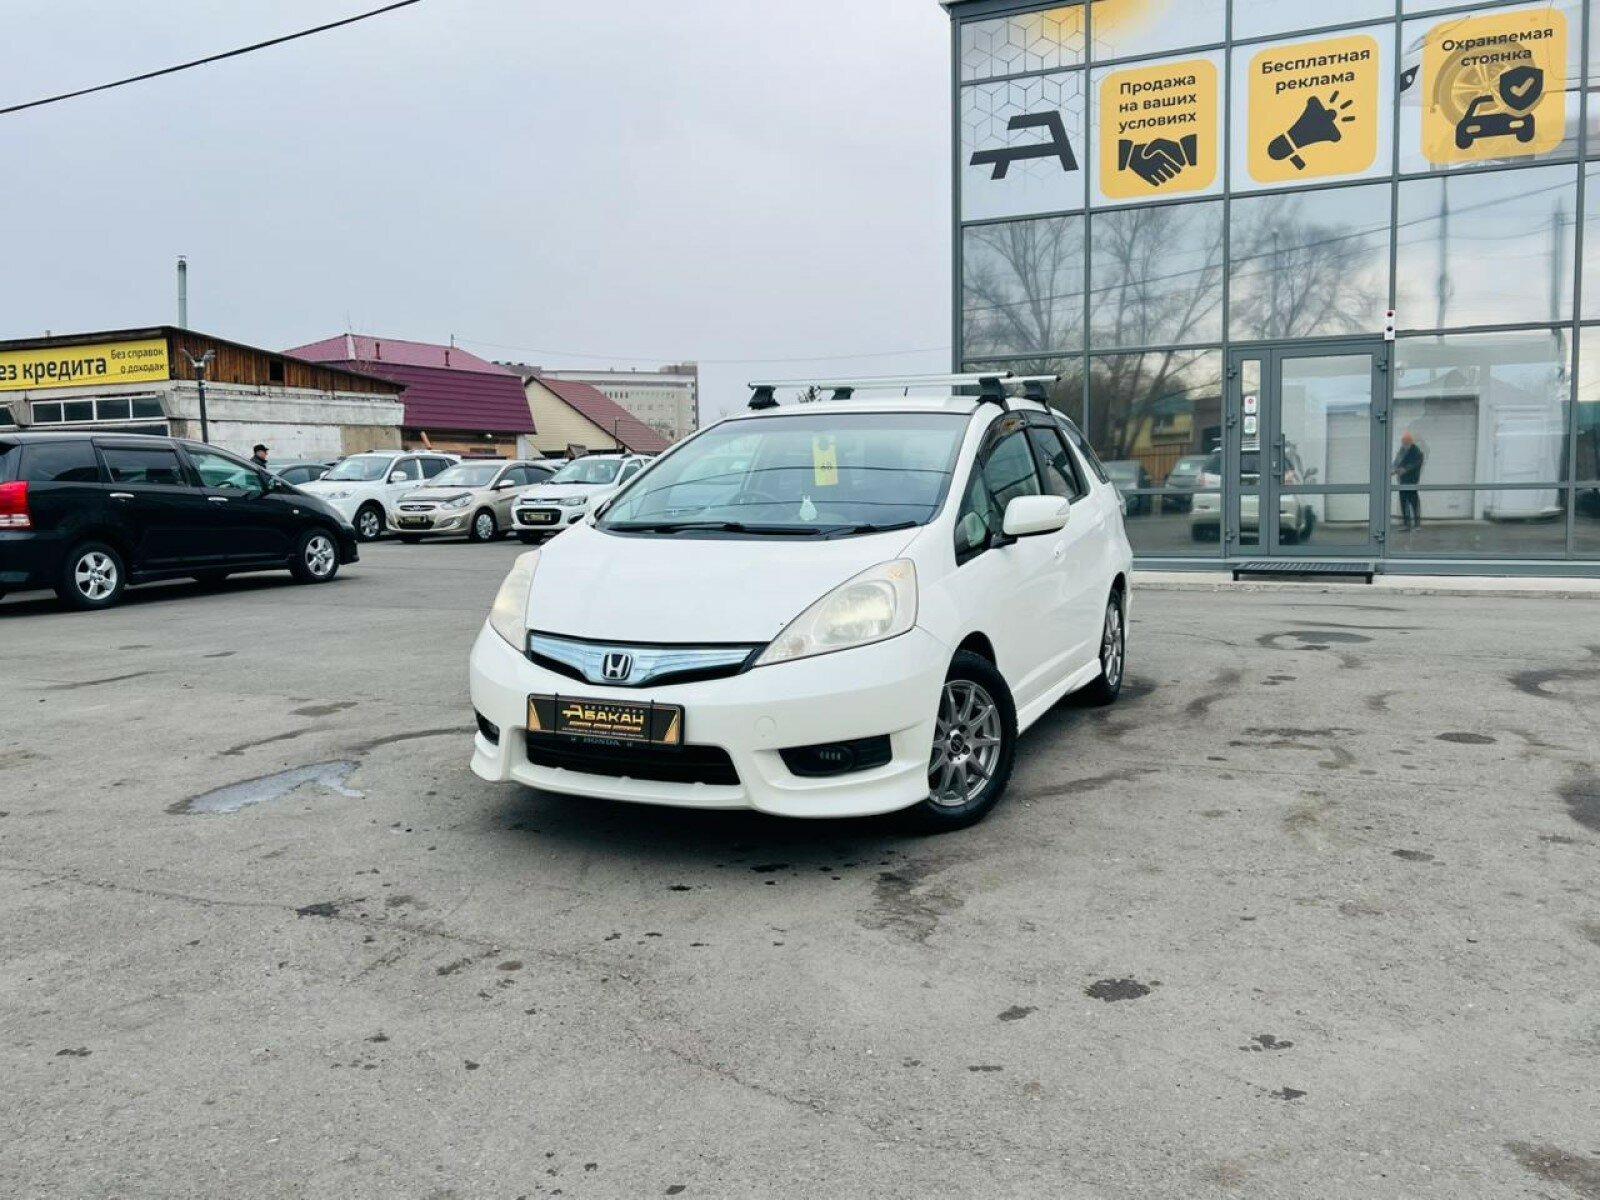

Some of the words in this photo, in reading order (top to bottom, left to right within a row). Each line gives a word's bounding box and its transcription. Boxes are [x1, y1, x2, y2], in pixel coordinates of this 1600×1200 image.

[1441, 28, 1553, 52] Охраняемая
[1261, 49, 1371, 74] Бесплатная
[1460, 49, 1532, 67] стоянка
[1120, 75, 1196, 95] Продажа
[1275, 71, 1356, 95] реклама
[1119, 101, 1138, 113] на
[1143, 93, 1197, 110] ваших
[1118, 112, 1196, 134] условиях
[110, 349, 126, 360] Без
[127, 348, 164, 359] справок
[22, 356, 107, 385] кредита
[120, 365, 126, 375] о
[127, 363, 165, 374] доходах
